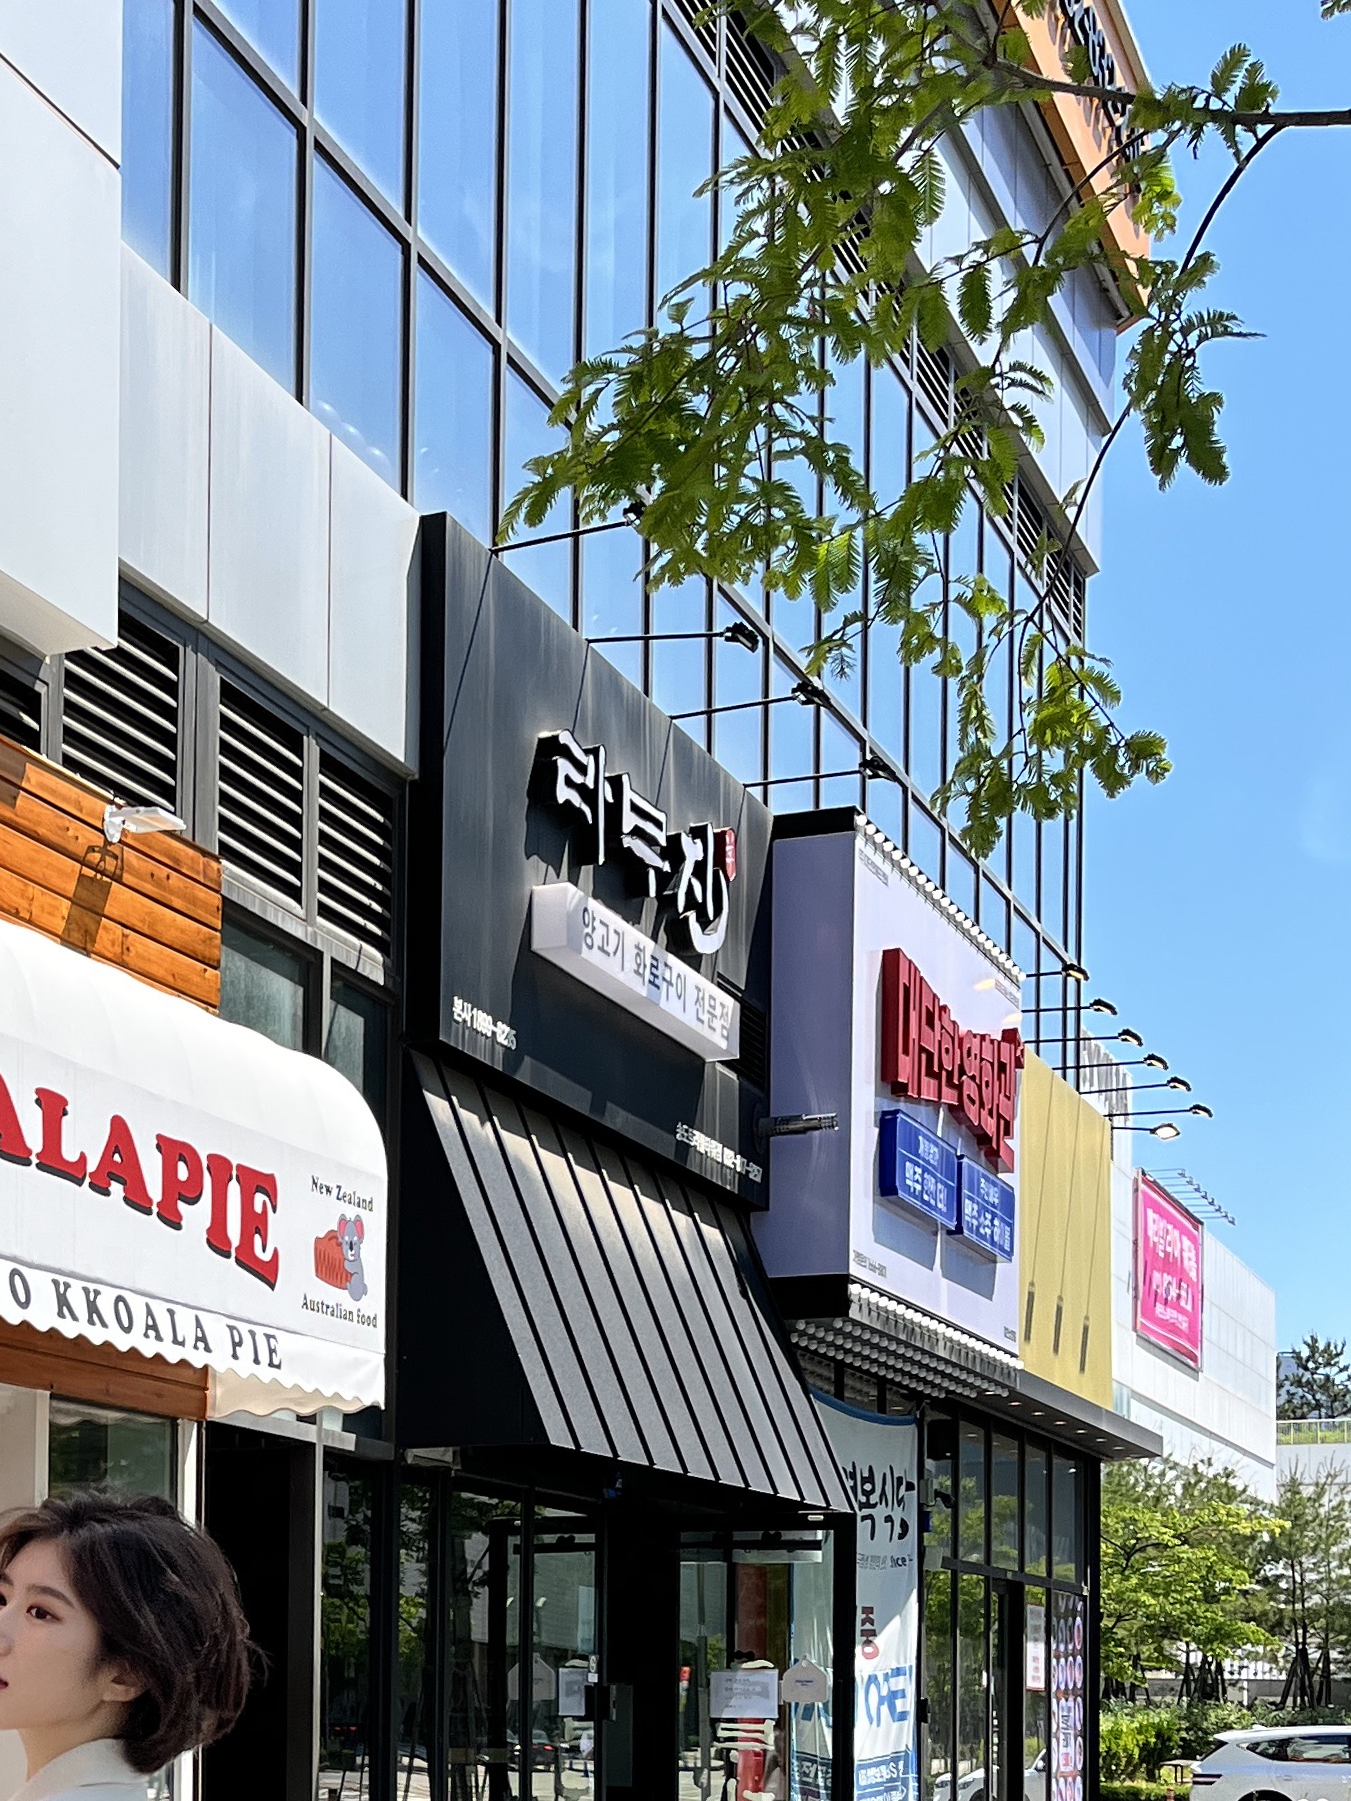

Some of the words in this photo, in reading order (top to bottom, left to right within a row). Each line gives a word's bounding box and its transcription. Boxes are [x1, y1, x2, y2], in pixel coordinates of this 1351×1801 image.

[551, 728, 729, 955] 라무진
[581, 906, 626, 972] 양고기
[633, 941, 688, 1014] 화로구이
[693, 984, 730, 1041] 전문점
[897, 948, 1019, 1173] 대단한영화관
[311, 1174, 333, 1197] New
[335, 1185, 374, 1212] Zealand
[51, 1278, 226, 1355] KKOALA
[226, 1322, 283, 1372] PIE
[301, 1293, 354, 1323] Australian
[356, 1308, 378, 1329] food
